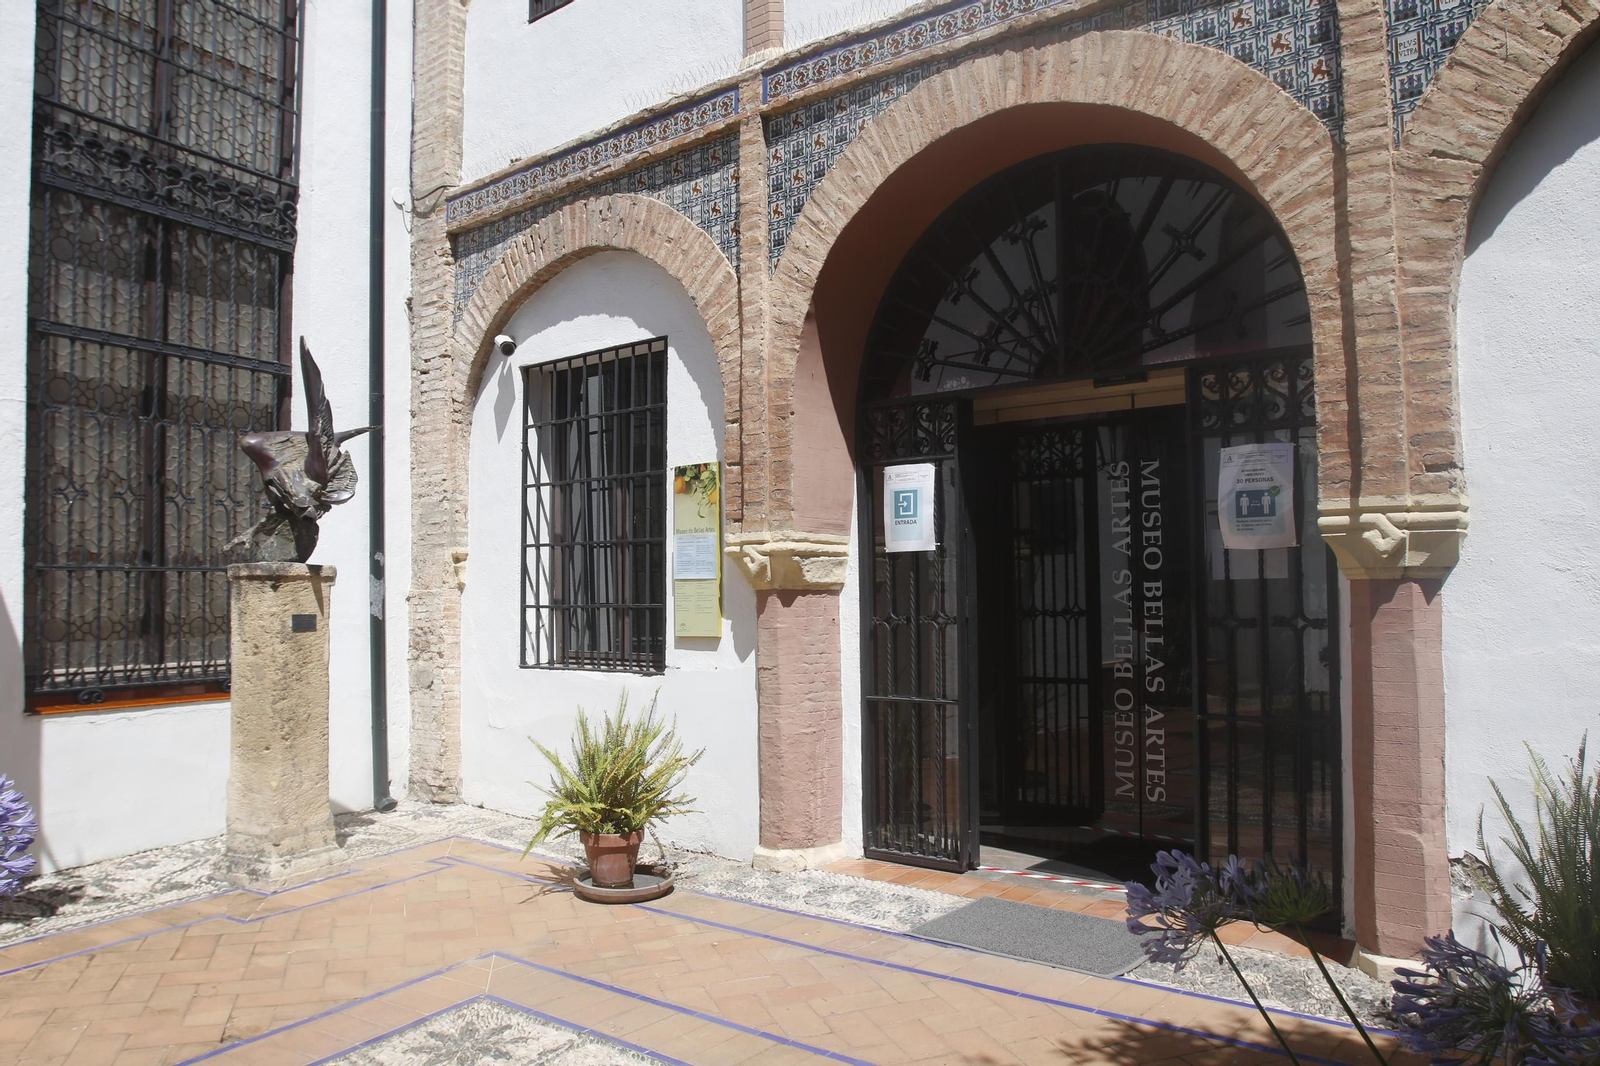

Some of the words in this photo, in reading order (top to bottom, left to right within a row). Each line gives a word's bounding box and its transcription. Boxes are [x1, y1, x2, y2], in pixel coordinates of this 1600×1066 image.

[1399, 38, 1417, 50] PLVS
[1109, 460, 1132, 557] ARTES
[1140, 458, 1163, 570] MUSEO
[1112, 569, 1134, 679] BELLAS
[1143, 579, 1165, 693] BELLAS
[1113, 688, 1135, 799] MUSEO
[1145, 703, 1167, 802] ARTES
